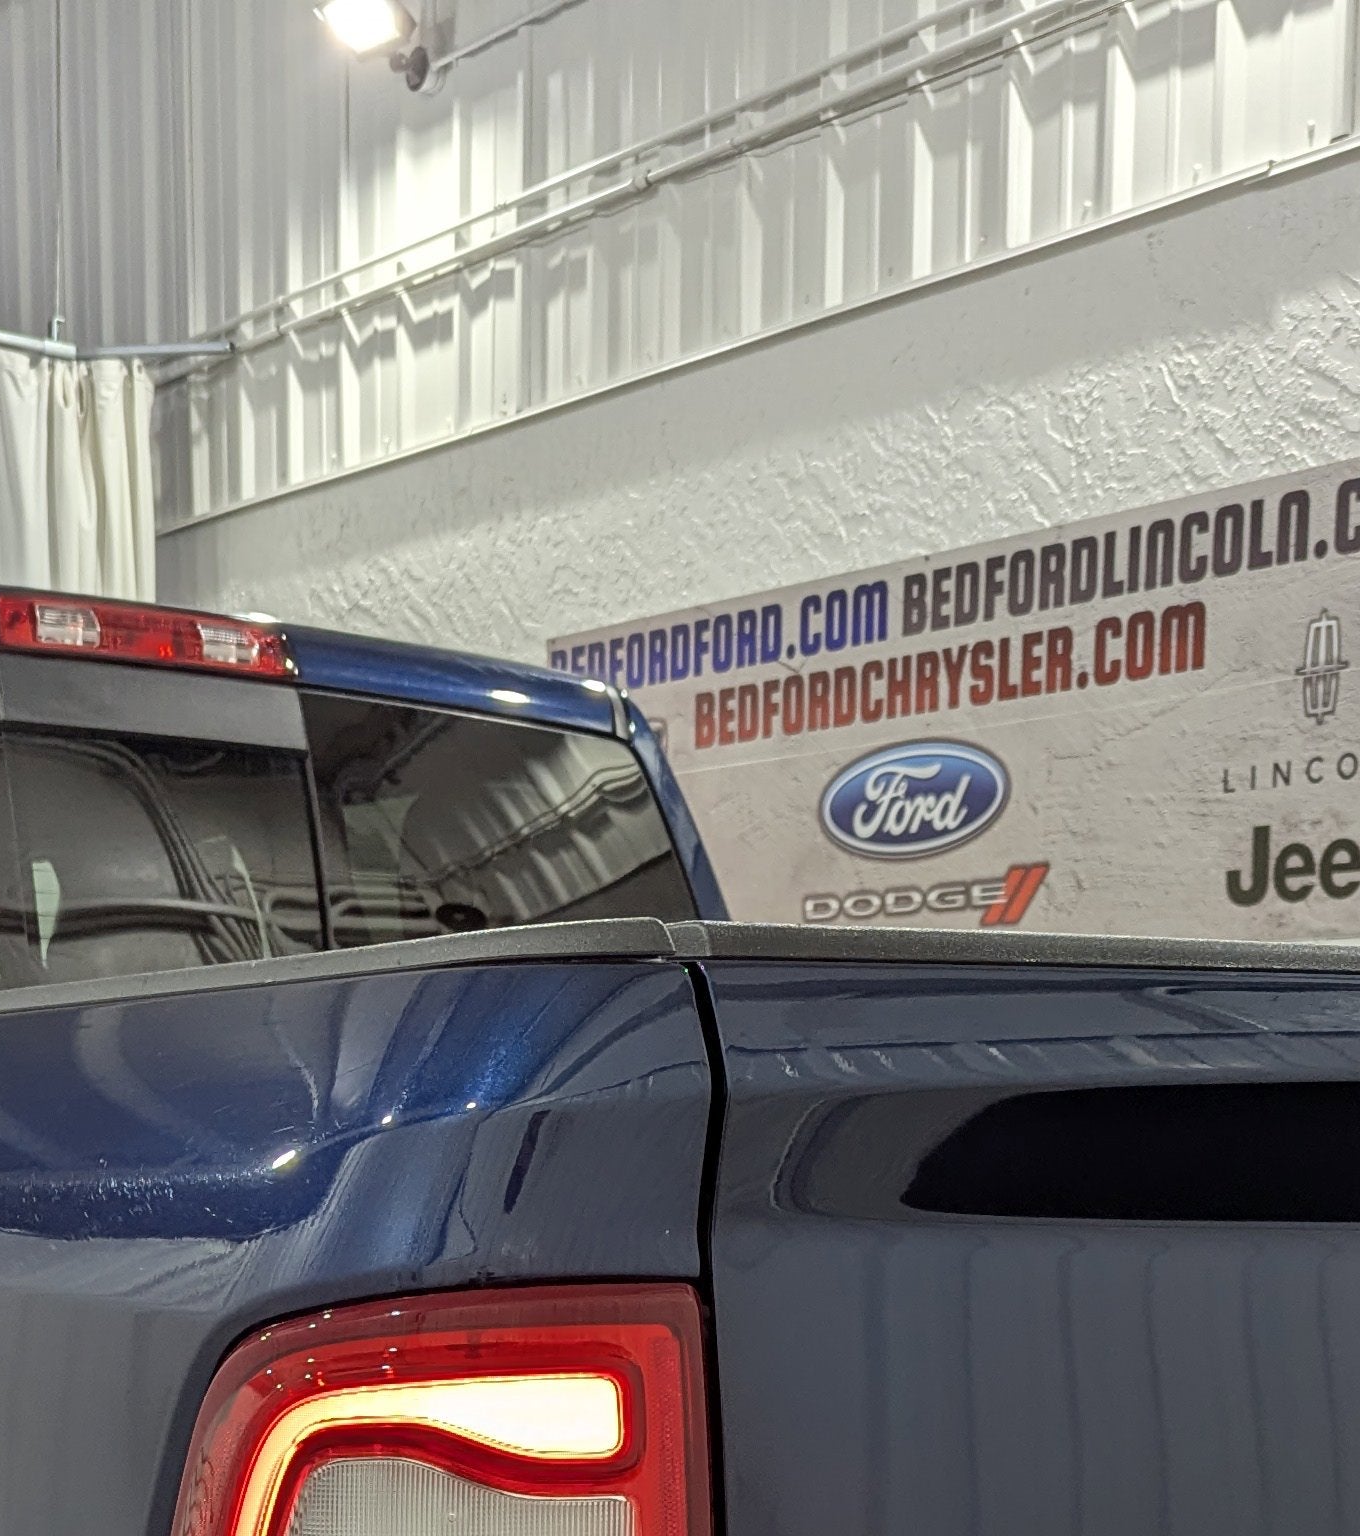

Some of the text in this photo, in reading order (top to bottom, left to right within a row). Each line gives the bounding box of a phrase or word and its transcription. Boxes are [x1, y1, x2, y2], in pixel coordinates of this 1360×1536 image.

[694, 601, 1207, 749] BEDFORDCHRYSLER.COM
[853, 763, 972, 839] Ford
[802, 878, 1010, 921] DODGE
